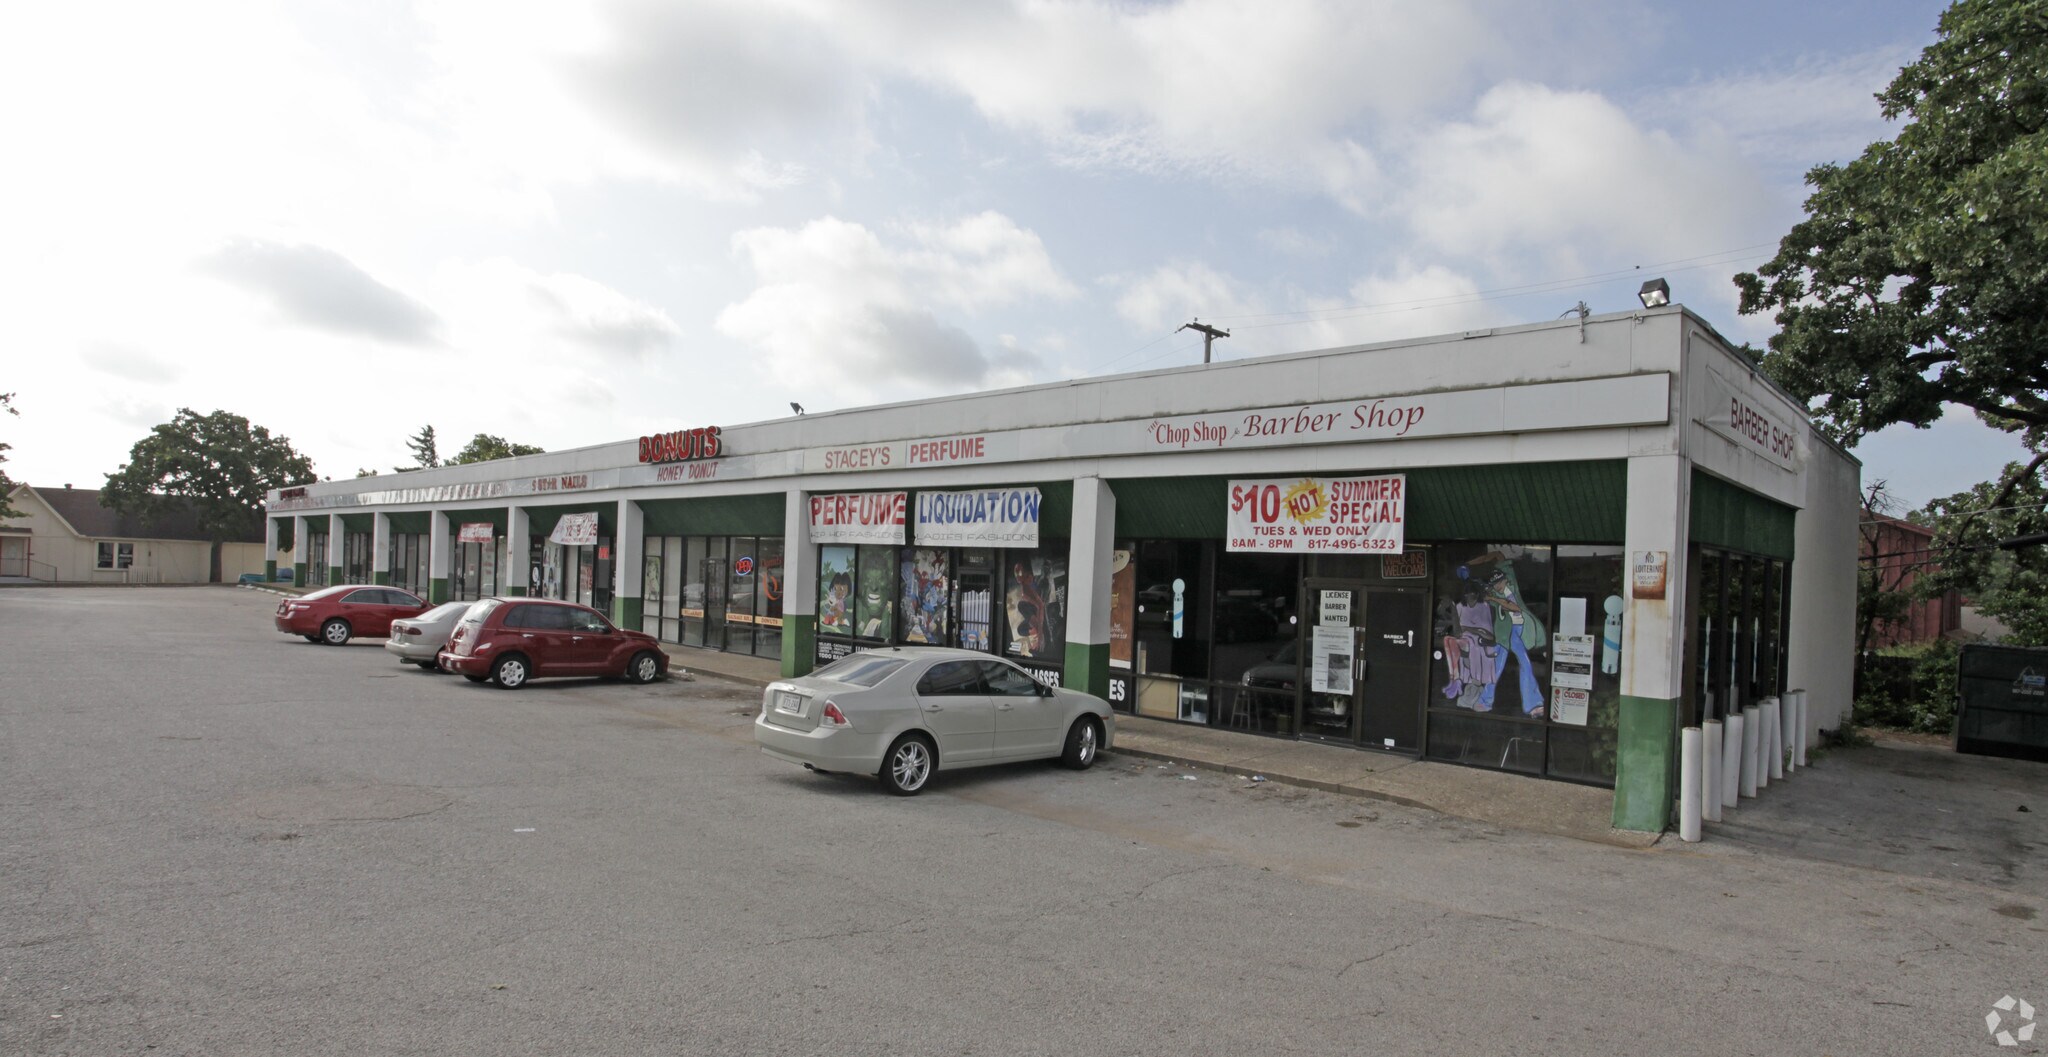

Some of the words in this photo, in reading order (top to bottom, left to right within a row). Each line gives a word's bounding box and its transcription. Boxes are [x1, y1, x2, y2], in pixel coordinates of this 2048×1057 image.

[1156, 423, 1190, 448] Chop
[1193, 421, 1227, 446] Shop
[1243, 406, 1341, 437] Barber
[1350, 400, 1424, 436] Shop
[1731, 396, 1769, 449] BARBER
[1772, 426, 1794, 460] SHOP
[639, 425, 721, 464] DONUTS
[825, 446, 890, 469] STACEY'S
[910, 437, 985, 463] PERFUME
[657, 465, 684, 481] HONEY
[688, 462, 718, 479] DONUT
[1331, 478, 1401, 501] SUMMER
[811, 493, 906, 526] PERFUME
[920, 491, 1038, 525] LIQUIDATION
[1231, 484, 1281, 524] $10
[1288, 487, 1319, 518] HOT
[1329, 501, 1401, 524] SPECIAL
[967, 533, 1038, 541] FASHIONS
[1253, 526, 1285, 536] TUES
[1289, 526, 1297, 536] &
[1303, 526, 1331, 536] WED
[1336, 526, 1370, 536] ONLY
[1232, 538, 1256, 548] 8AM
[1268, 539, 1293, 549] 8PM
[1308, 539, 1395, 549] 817-496-6323
[736, 560, 752, 572] OPEN
[1385, 553, 1424, 565] WALK-INS
[1636, 564, 1664, 573] LOITERING
[1645, 554, 1654, 563] NO
[1384, 565, 1425, 576] WELCOME
[1563, 691, 1586, 700] CLOSED
